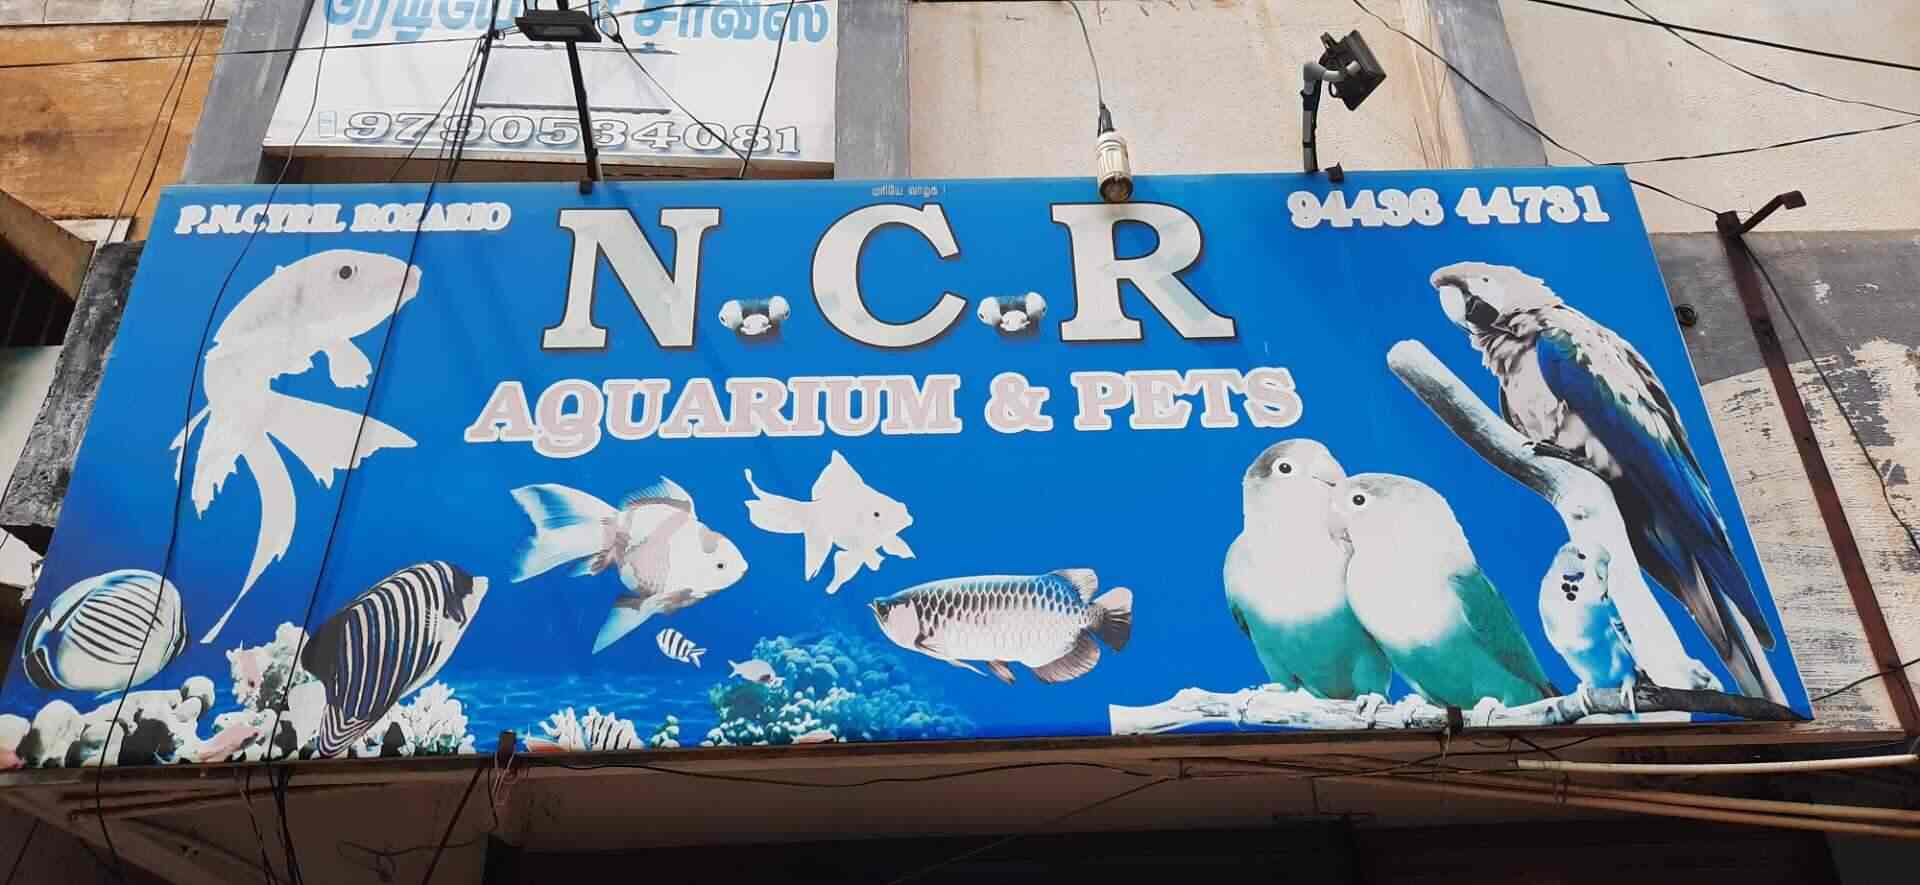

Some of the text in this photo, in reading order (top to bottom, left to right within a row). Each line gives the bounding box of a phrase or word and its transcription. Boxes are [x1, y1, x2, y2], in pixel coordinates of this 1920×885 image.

[343, 111, 801, 154] 9790534081
[1288, 186, 1609, 228] 94436 44731
[464, 366, 1303, 457] AQUARIUM & PETS
